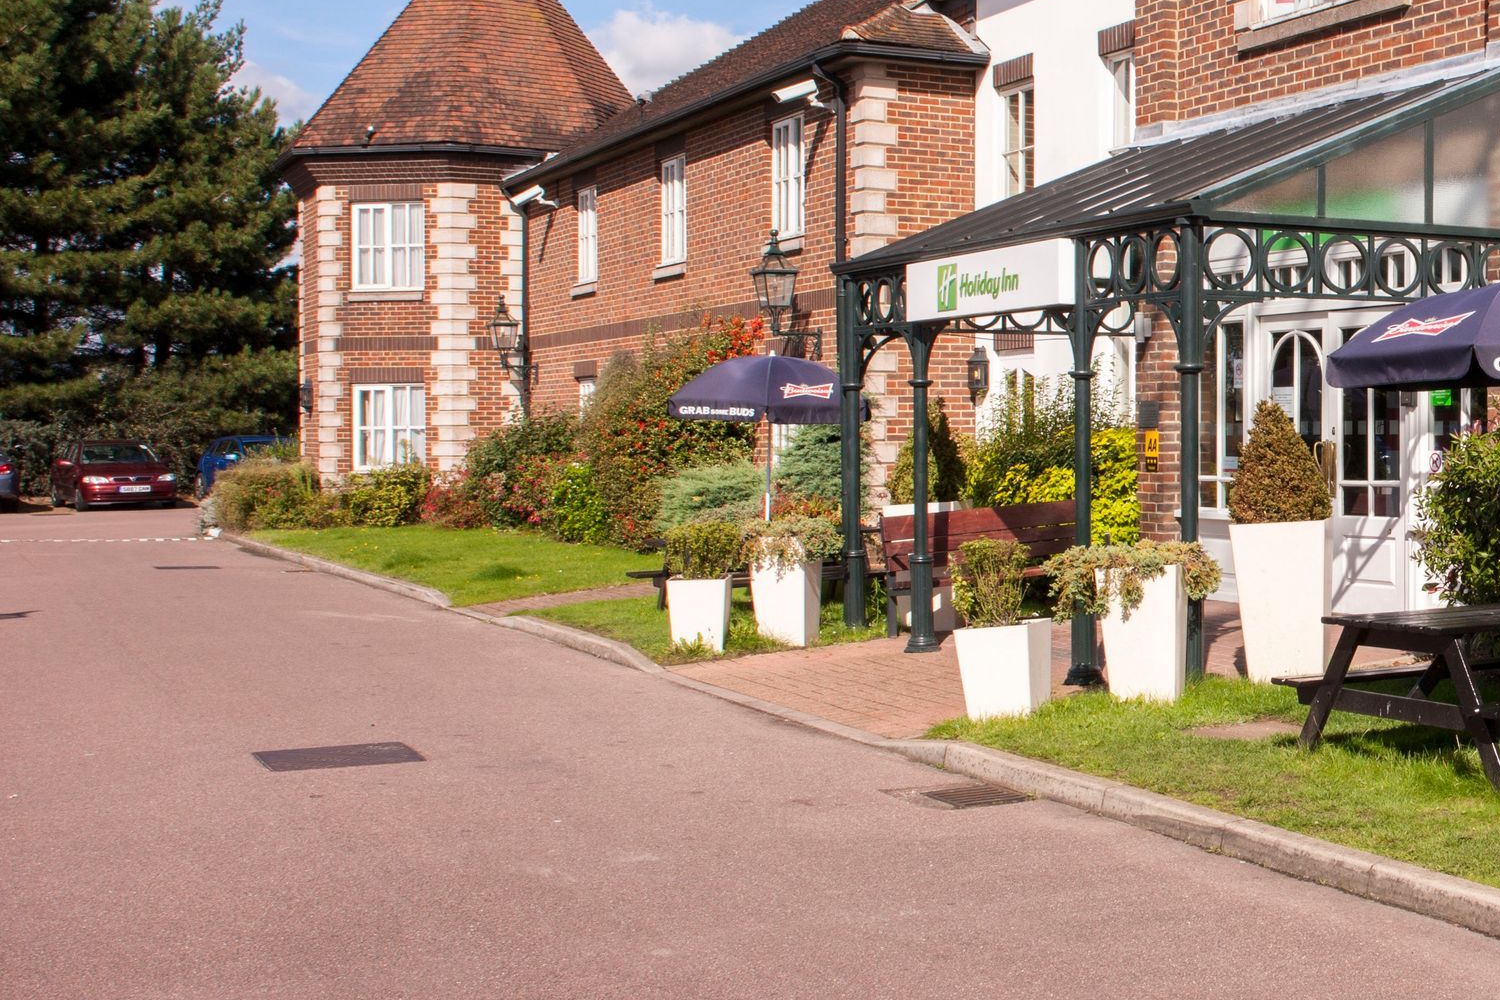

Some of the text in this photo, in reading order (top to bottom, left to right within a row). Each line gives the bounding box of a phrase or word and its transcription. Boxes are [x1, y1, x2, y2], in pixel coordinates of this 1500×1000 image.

[960, 267, 1019, 300] Holiday Inn
[679, 406, 710, 415] GRAB
[729, 407, 756, 417] BUDS
[1148, 438, 1157, 452] AA
